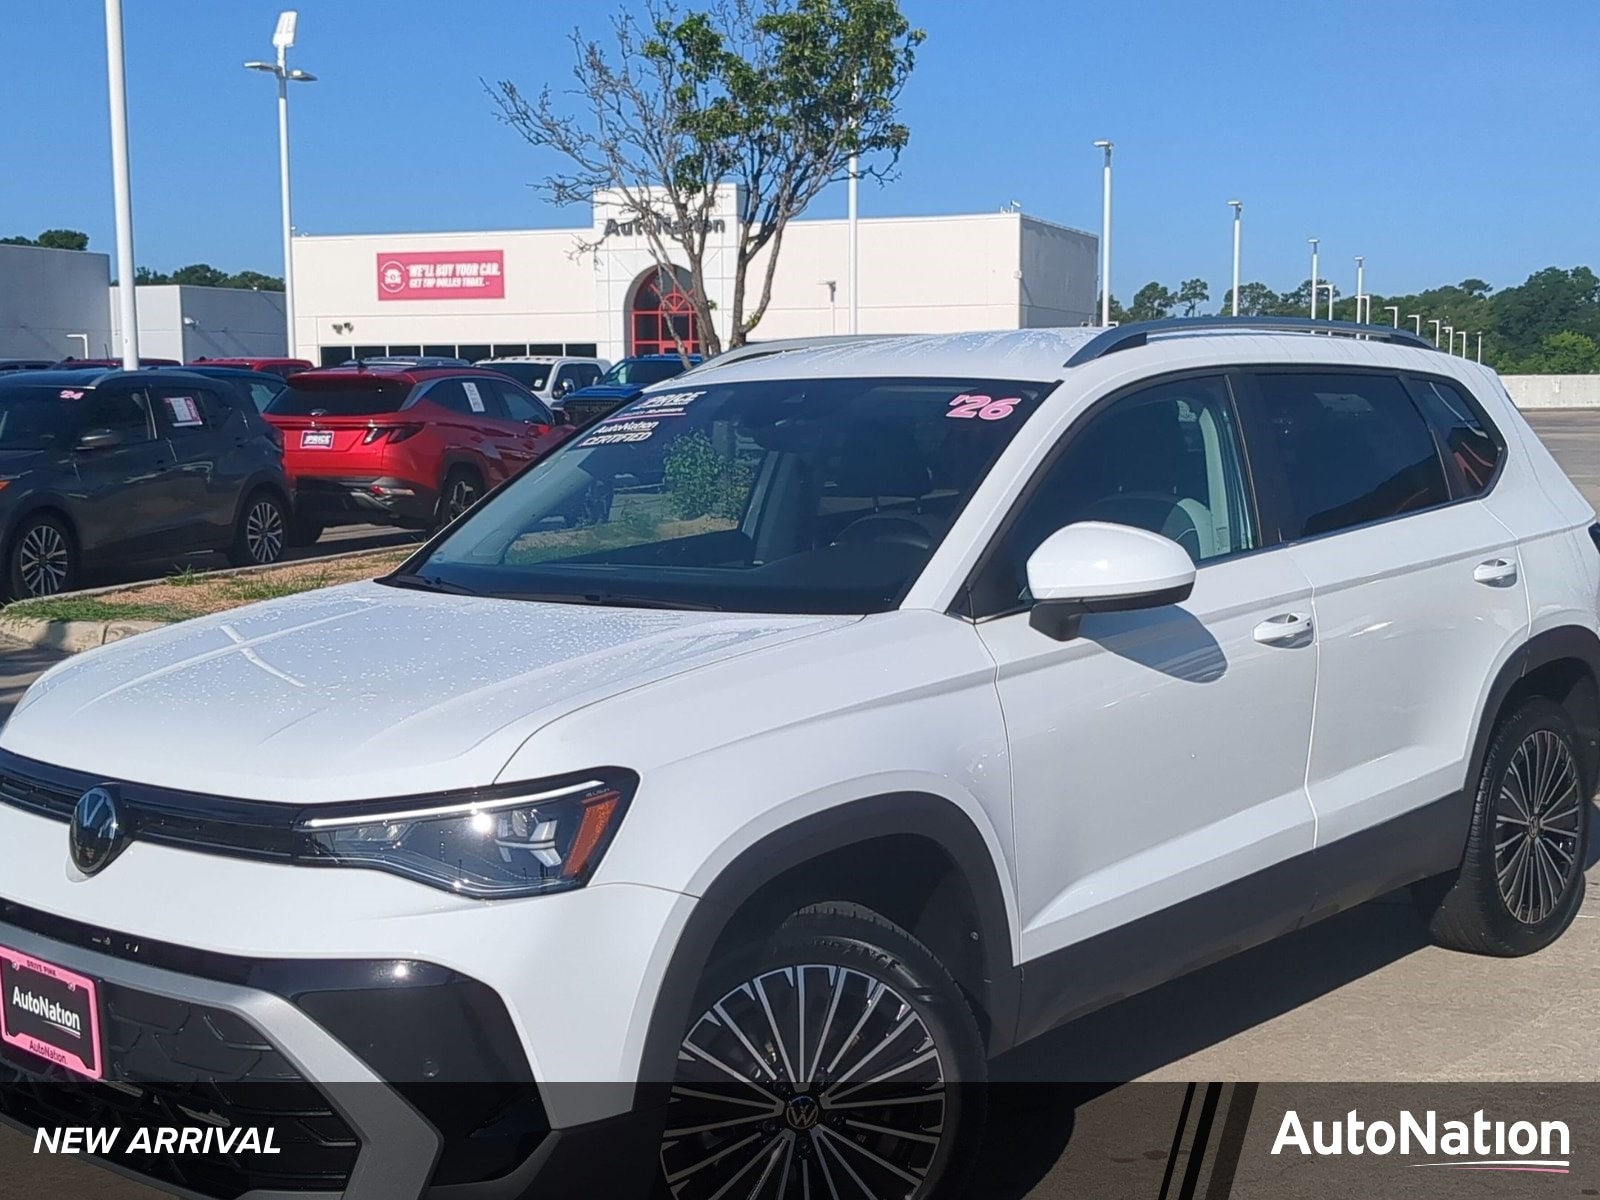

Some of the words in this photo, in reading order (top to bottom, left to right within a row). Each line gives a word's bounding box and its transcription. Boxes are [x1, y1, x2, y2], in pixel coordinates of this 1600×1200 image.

[604, 218, 725, 236] AutNaon
[592, 421, 659, 434] AutoNation
[577, 432, 653, 447] CERTIFIED
[12, 986, 80, 1030] AutoNation
[29, 1040, 67, 1063] AutoNation
